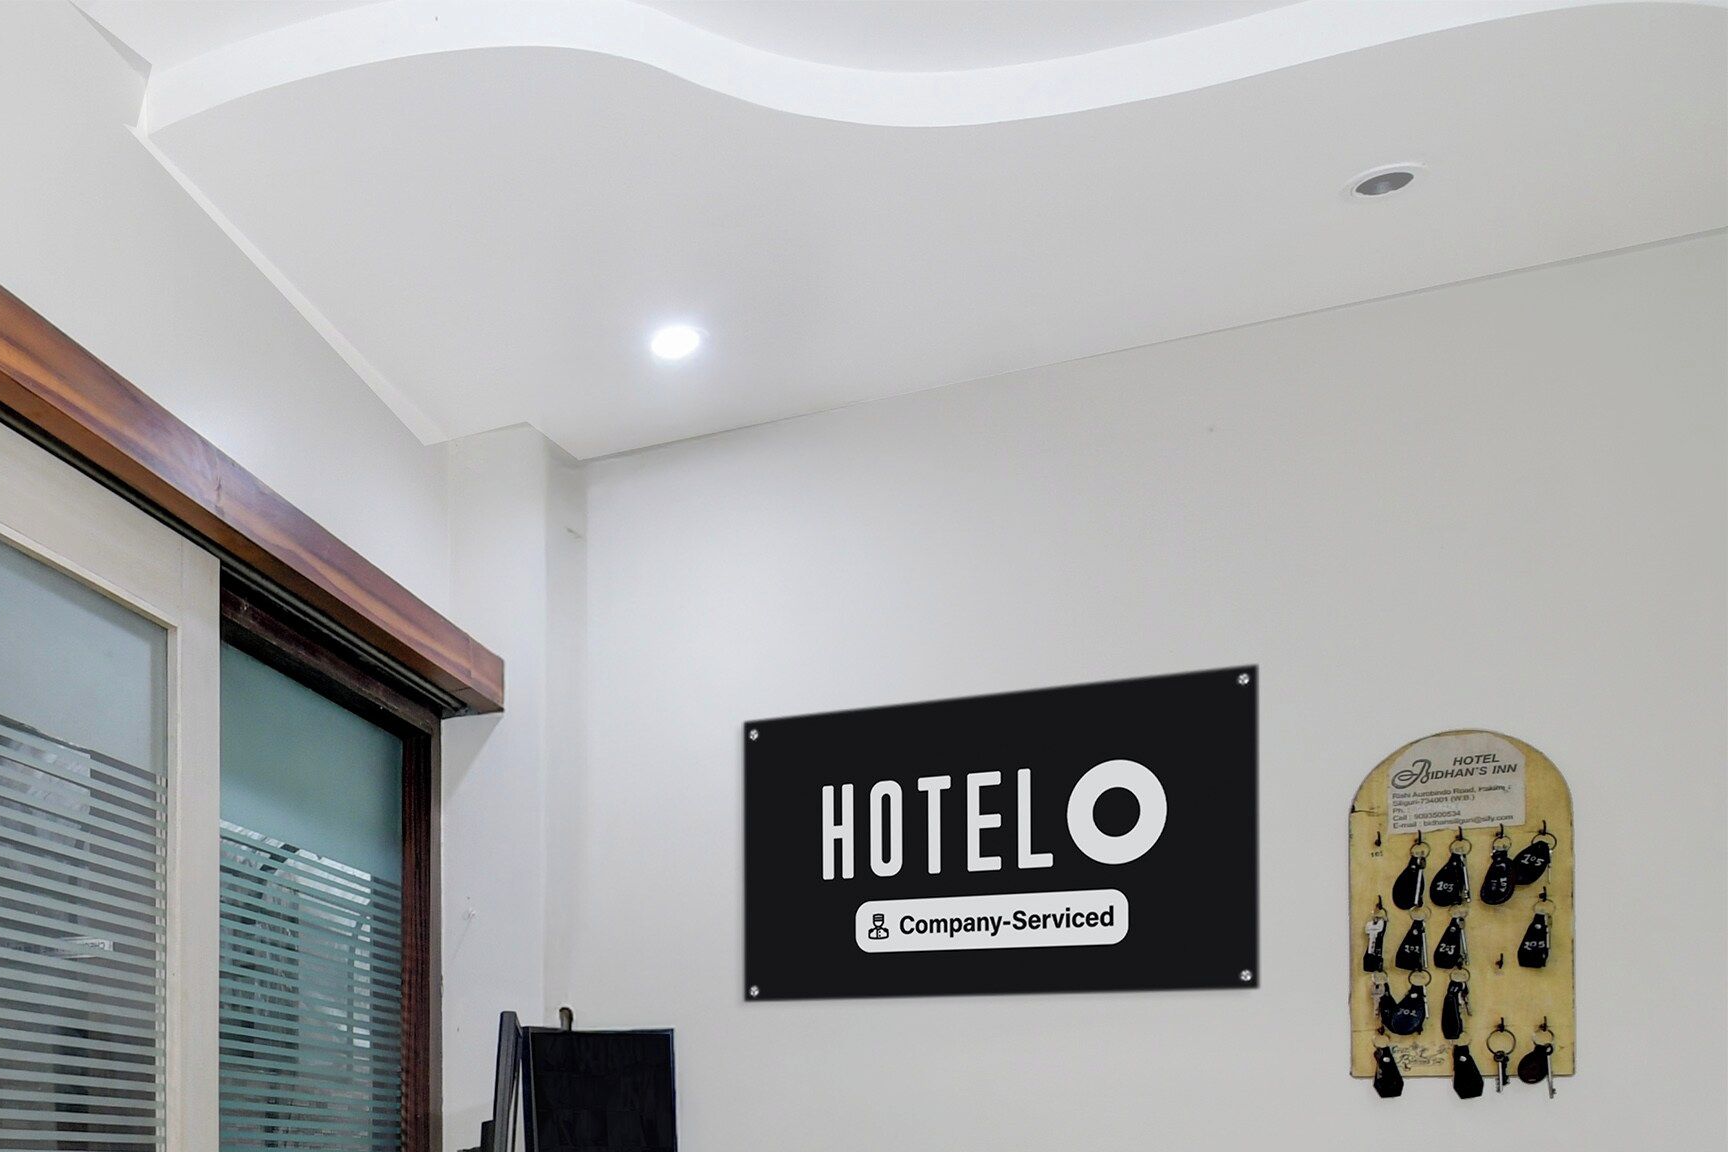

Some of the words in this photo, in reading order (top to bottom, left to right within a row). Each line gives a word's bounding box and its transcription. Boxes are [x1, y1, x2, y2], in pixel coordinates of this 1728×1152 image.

[1452, 753, 1500, 767] HOTEL
[1391, 758, 1488, 789] BIDHAN'S
[1491, 763, 1518, 775] INN
[821, 768, 1054, 881] HOTEL
[1520, 853, 1545, 867] 105
[1436, 880, 1455, 893] 103
[898, 904, 1116, 938] Company-Serviced
[1404, 944, 1421, 954] 202
[1439, 943, 1456, 956] 203
[1523, 940, 1546, 951] 205
